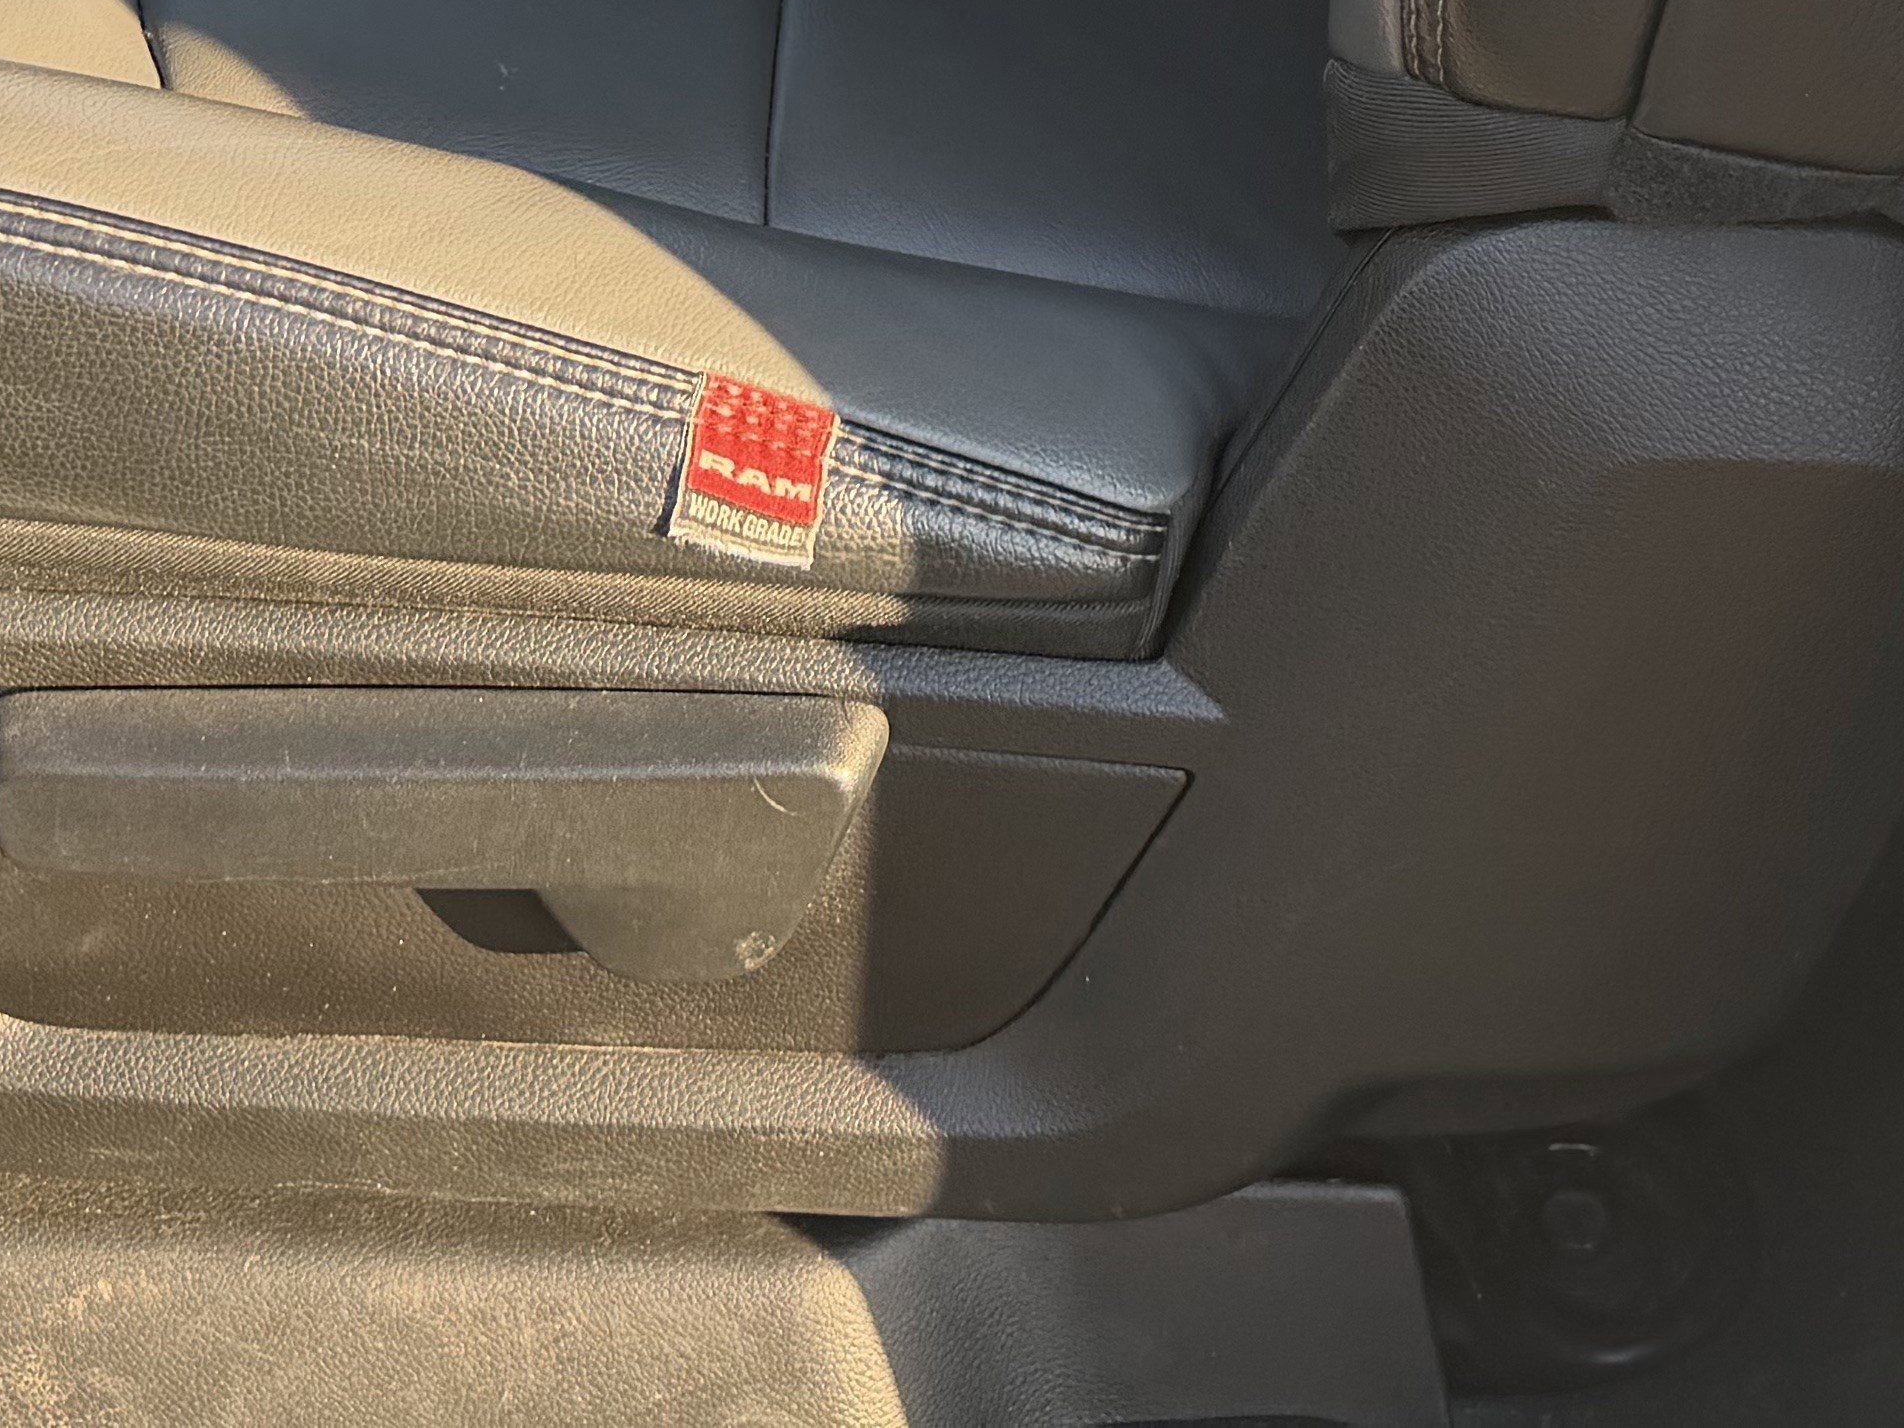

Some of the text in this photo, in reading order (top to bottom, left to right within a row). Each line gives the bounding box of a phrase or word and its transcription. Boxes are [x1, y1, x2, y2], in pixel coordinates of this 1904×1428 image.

[699, 449, 813, 503] RAM
[688, 493, 806, 547] WORK GRADE
